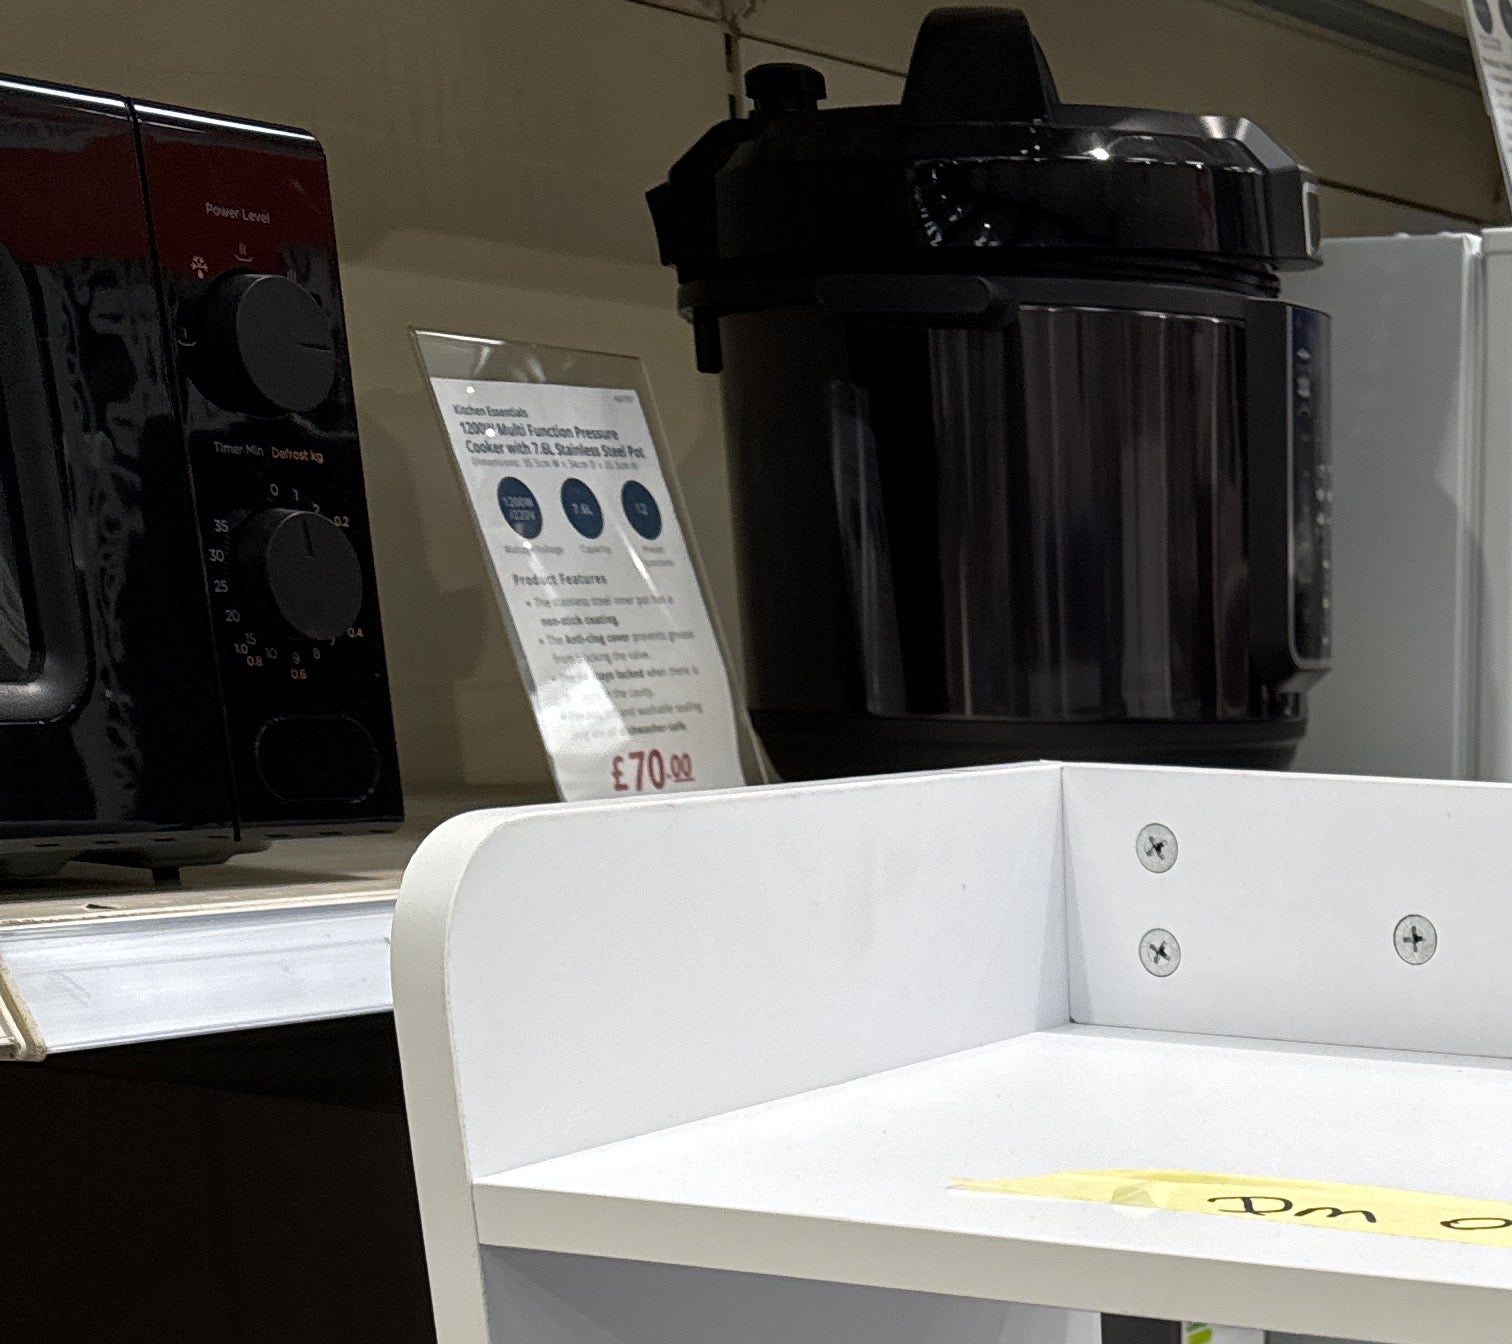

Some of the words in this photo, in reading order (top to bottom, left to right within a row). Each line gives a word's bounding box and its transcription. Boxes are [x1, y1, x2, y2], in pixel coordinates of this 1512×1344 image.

[205, 202, 239, 219] Power
[242, 208, 271, 224] Level
[496, 423, 526, 437] Multi
[527, 424, 574, 439] Function
[574, 426, 619, 441] Pressure
[213, 441, 243, 456] Timer
[271, 446, 309, 461] Defrost
[310, 448, 324, 464] kg
[465, 440, 504, 454] Cooker
[506, 441, 532, 455] with
[555, 443, 600, 458] Stainless
[601, 444, 627, 458] Steel
[628, 445, 645, 459] Pot
[270, 483, 279, 496] 0
[213, 519, 229, 533] 35
[209, 549, 225, 563] 30
[213, 579, 229, 593] 25
[559, 573, 607, 586] Features
[225, 609, 240, 622] 20
[611, 749, 695, 792] £70.00
